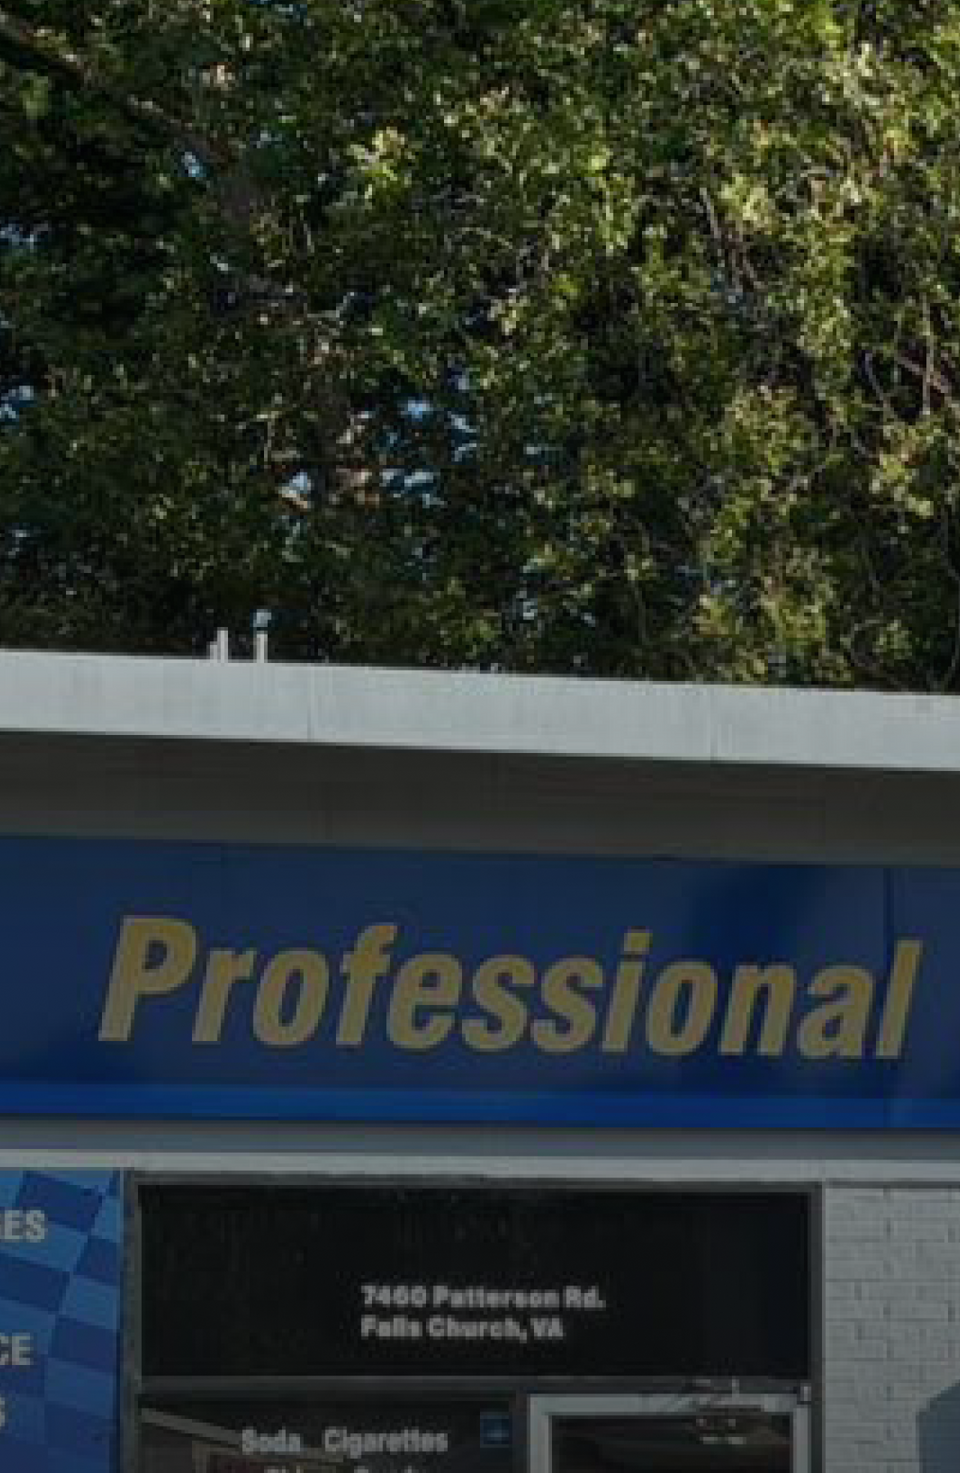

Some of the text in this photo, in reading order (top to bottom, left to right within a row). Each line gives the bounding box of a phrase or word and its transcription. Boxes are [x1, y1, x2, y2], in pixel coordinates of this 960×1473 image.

[97, 914, 924, 1061] Professional
[431, 1284, 561, 1310] Patterson
[563, 1284, 607, 1311] Rd.
[360, 1314, 567, 1344] Falls Church, VA
[241, 1425, 448, 1460] Soda Cigarettes
